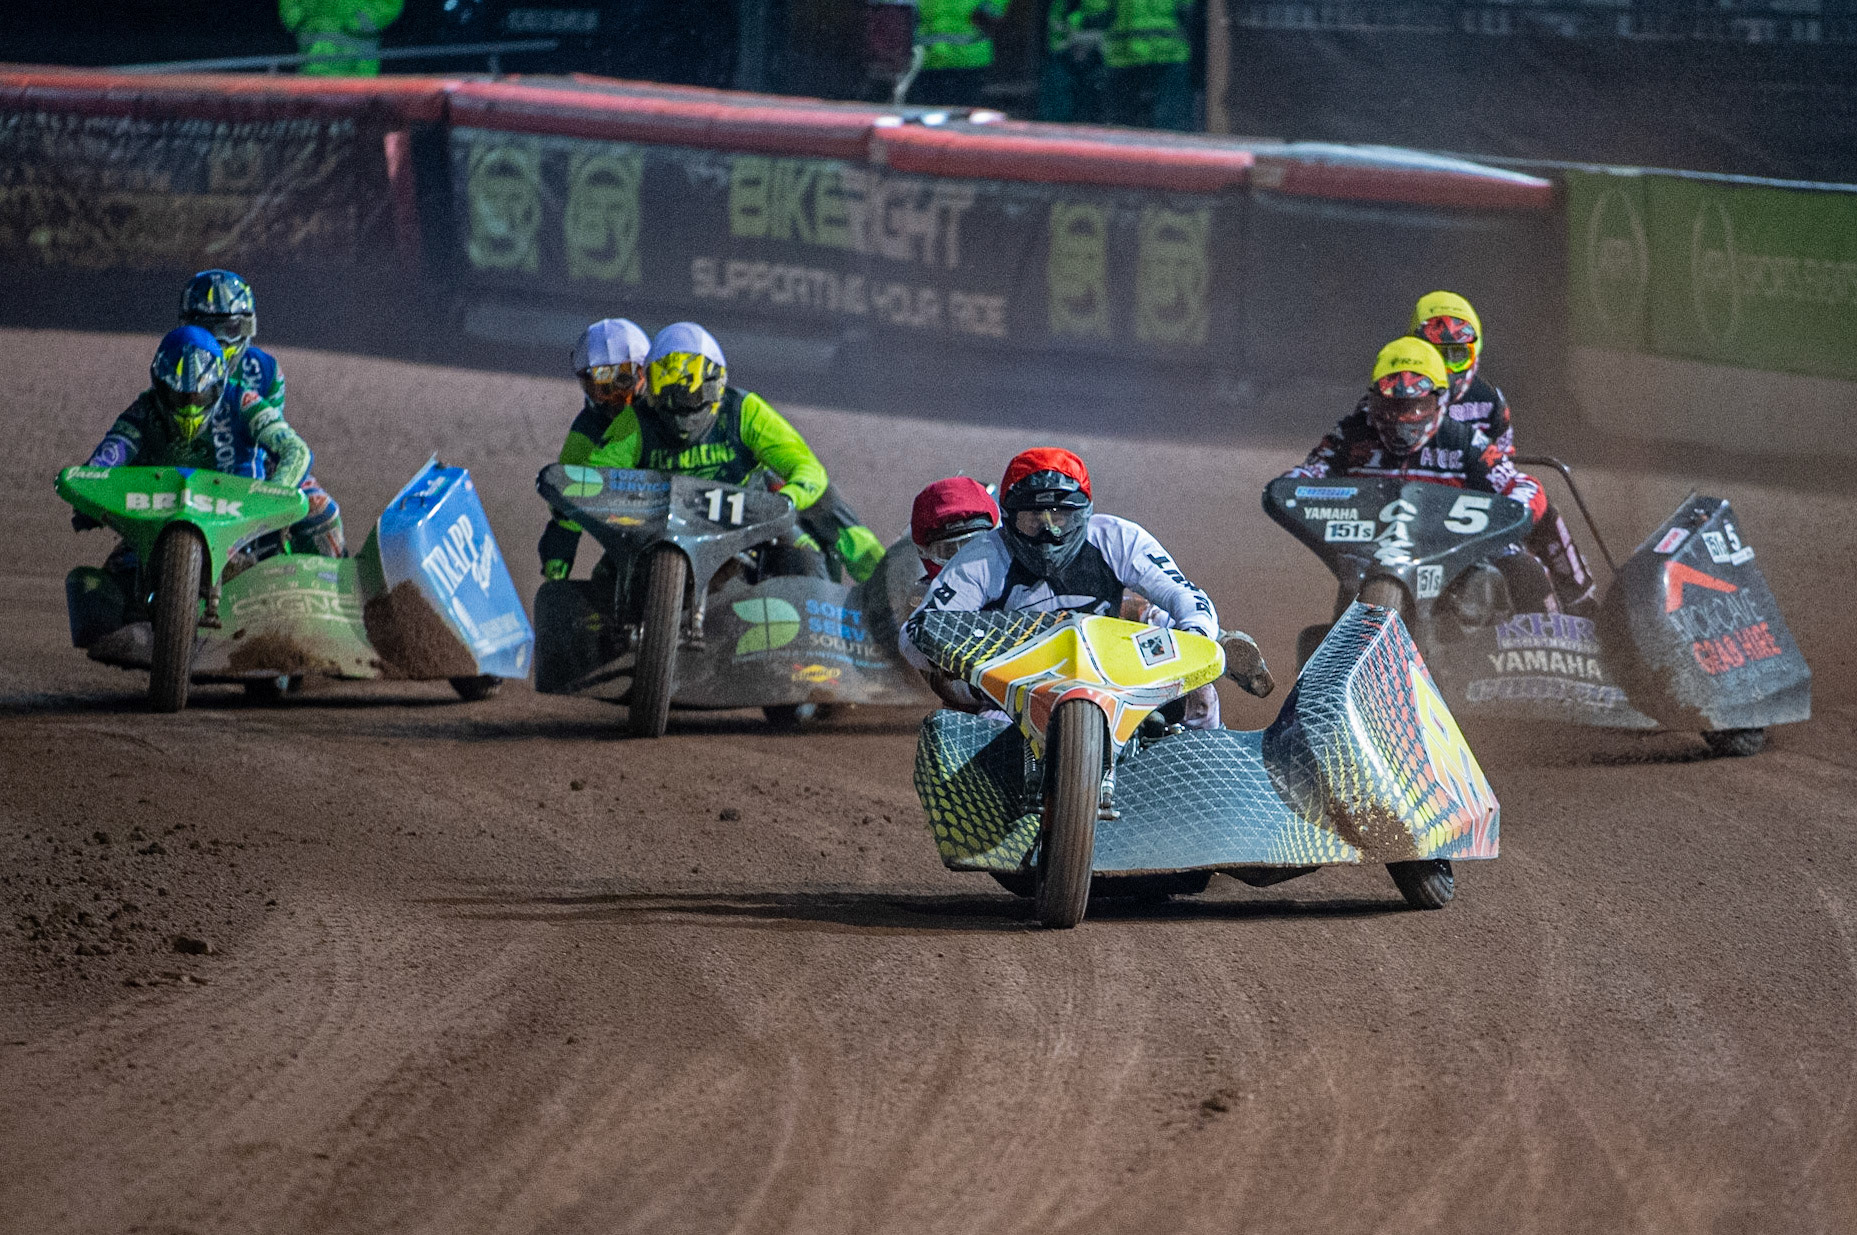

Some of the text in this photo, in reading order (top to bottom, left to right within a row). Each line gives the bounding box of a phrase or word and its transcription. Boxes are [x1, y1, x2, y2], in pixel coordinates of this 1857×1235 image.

[126, 488, 243, 518] BRISK
[704, 488, 745, 526] 11
[1304, 507, 1358, 520] YAMAHA
[1443, 495, 1493, 534] 5
[1724, 522, 1742, 551] 5
[421, 513, 480, 596] TRAPP
[1488, 649, 1603, 681] YAMAHA
